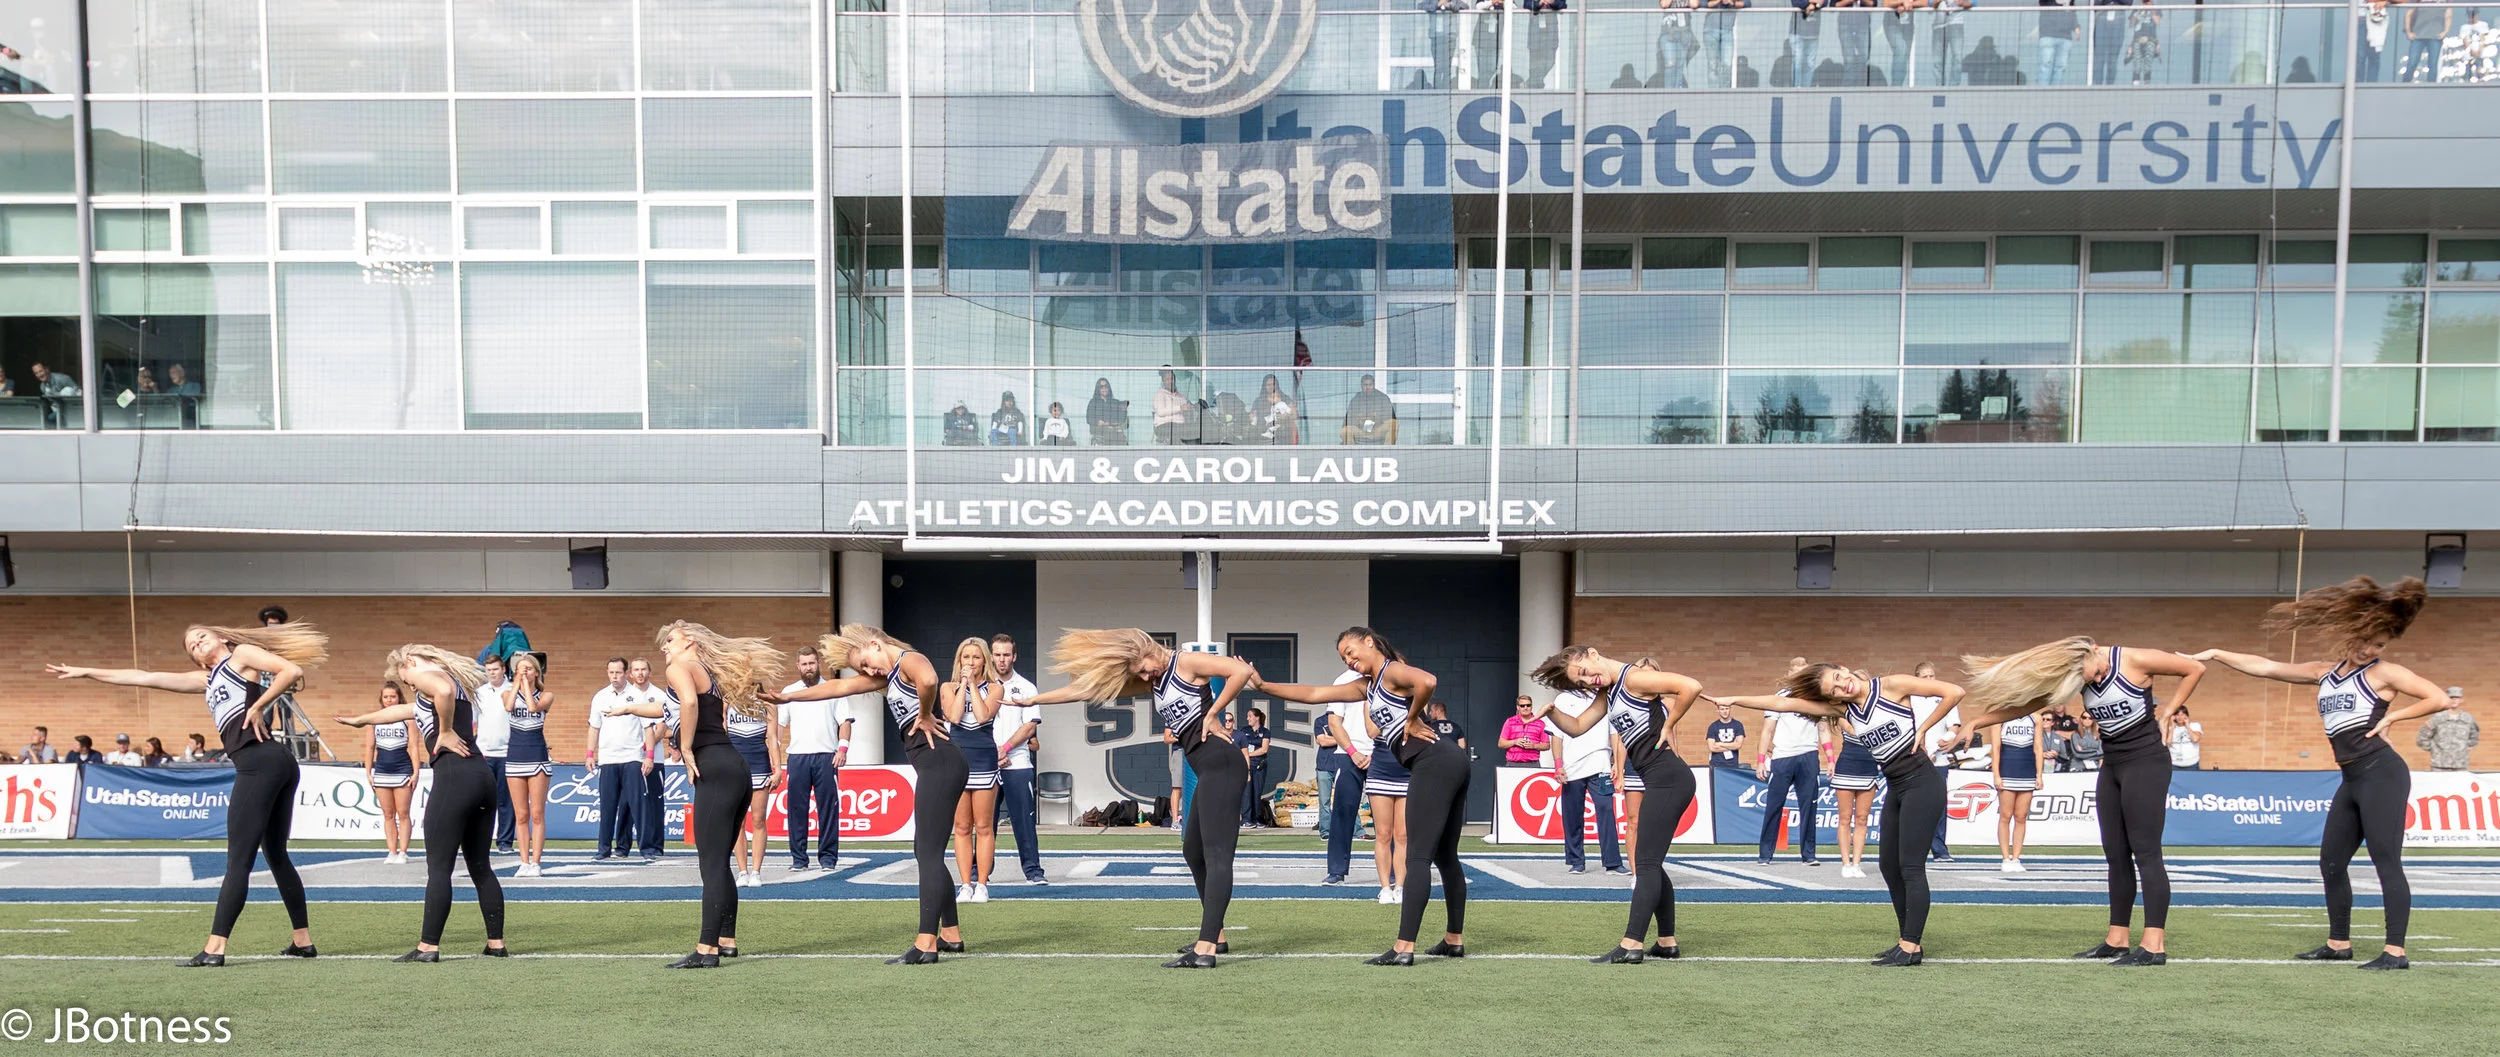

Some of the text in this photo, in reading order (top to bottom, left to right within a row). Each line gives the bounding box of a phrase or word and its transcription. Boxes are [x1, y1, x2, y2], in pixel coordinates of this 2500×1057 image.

[1008, 145, 1382, 239] Allstate
[1002, 457, 1399, 484] JIM & CAROL LAUB
[848, 499, 1556, 527] ATHLETICS-ACADEMICS COMPLEX
[376, 728, 405, 738] AGGIES
[0, 775, 57, 823] h's
[300, 791, 327, 807] LA
[162, 808, 209, 820] ONLINE
[2233, 813, 2282, 825] ONLINE
[326, 818, 361, 829] INN
